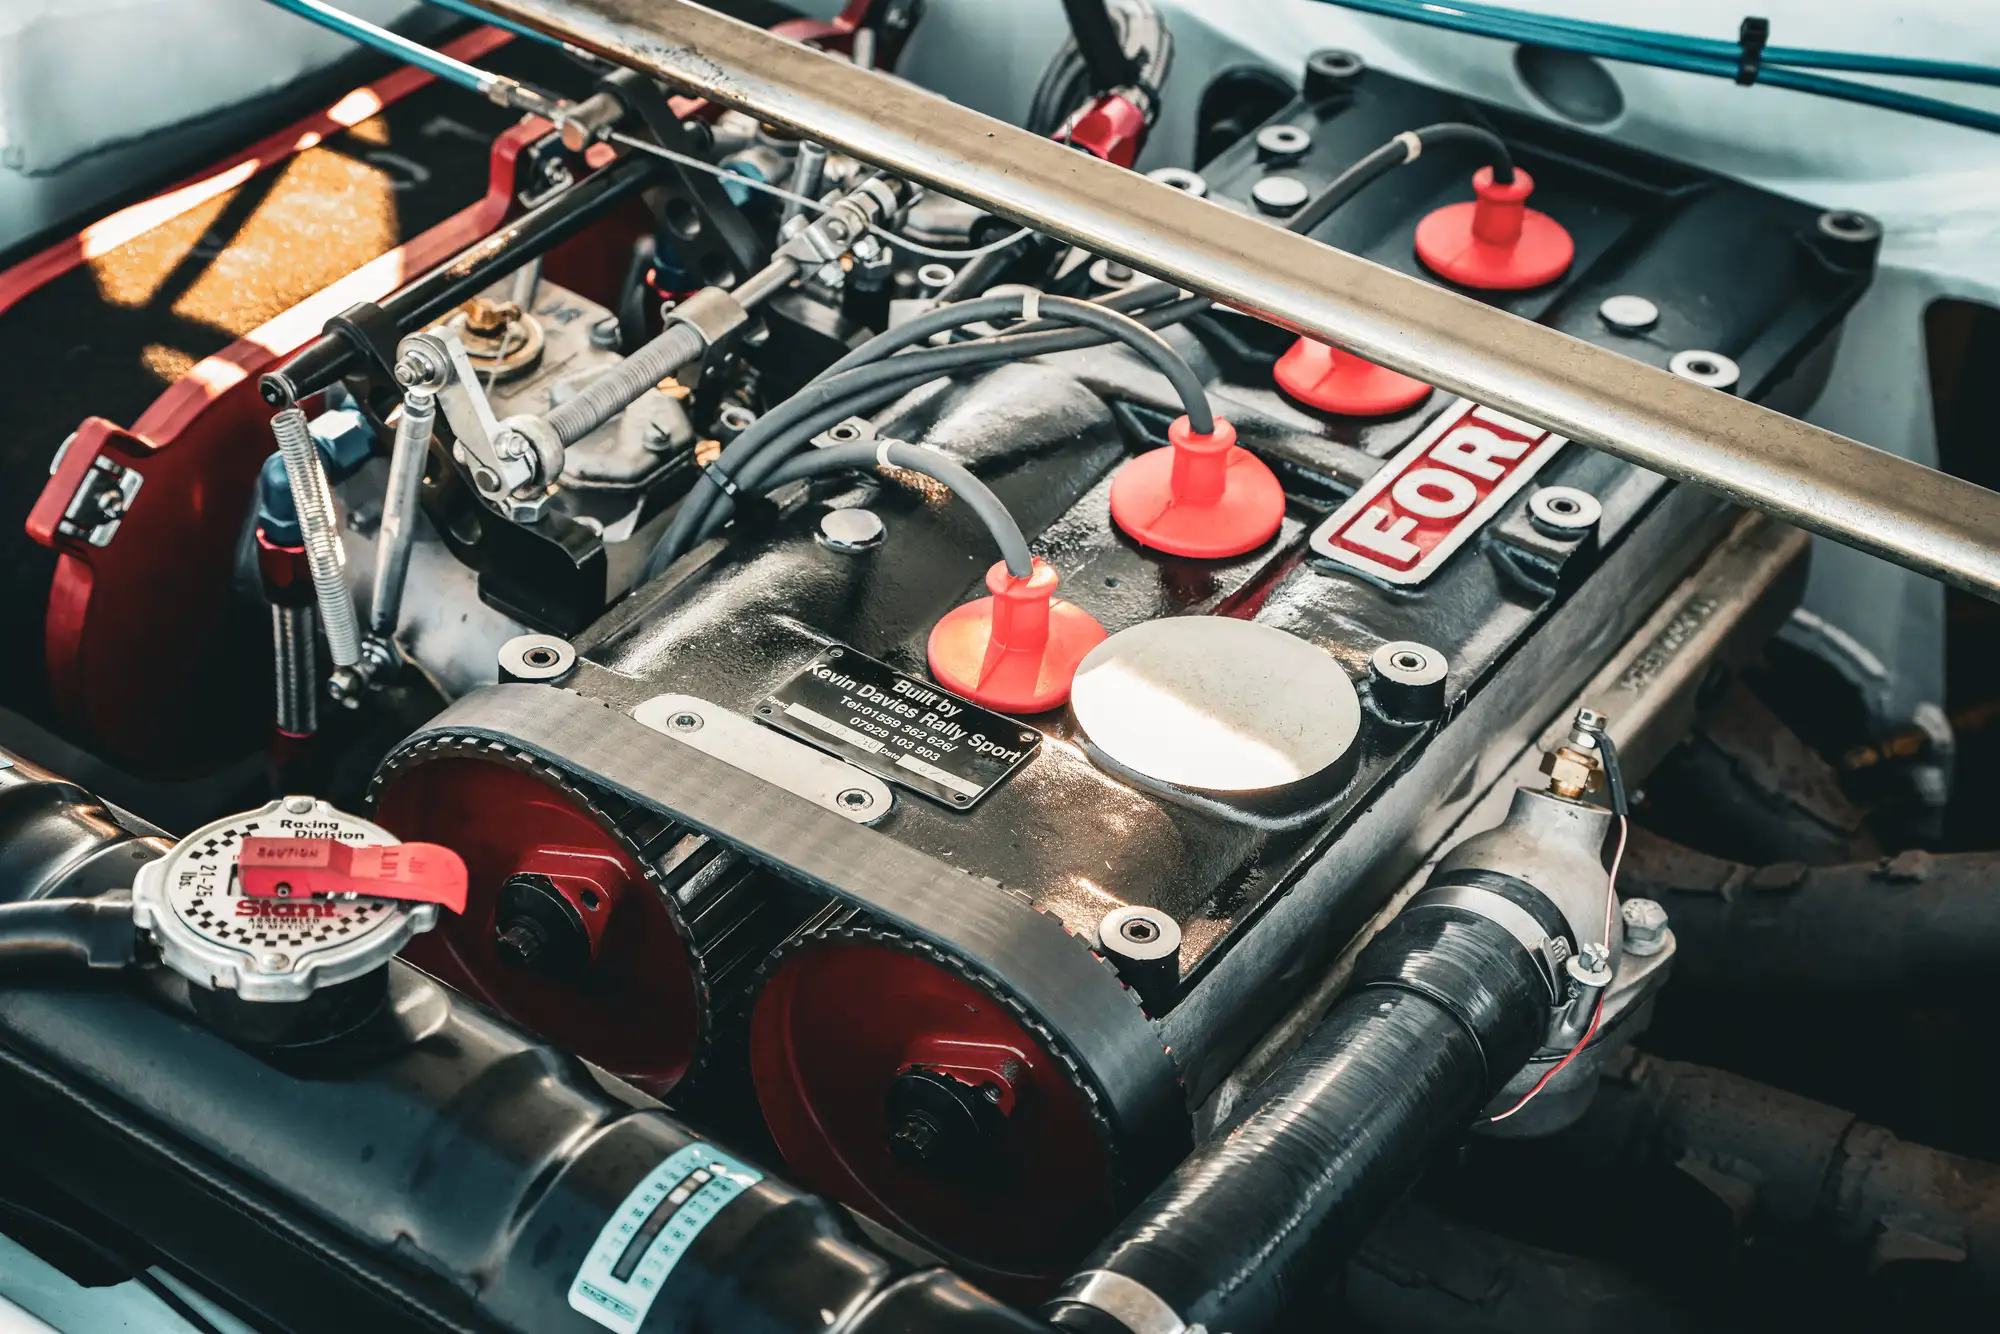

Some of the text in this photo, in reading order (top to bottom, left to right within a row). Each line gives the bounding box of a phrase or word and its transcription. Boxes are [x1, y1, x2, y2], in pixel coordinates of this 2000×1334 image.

[766, 695, 789, 710] Spec
[892, 679, 963, 718] Built by
[804, 660, 1022, 765] Kevin Davies Rally Sport
[840, 696, 901, 729] Tel:01559
[901, 722, 927, 740] 362
[850, 716, 941, 762] 07929 103 903
[880, 747, 900, 761] Date
[280, 819, 339, 830] Racing
[295, 830, 365, 840] Division
[257, 846, 319, 858] CAUTION
[195, 864, 217, 897] 21-25
[235, 899, 337, 918] Stant
